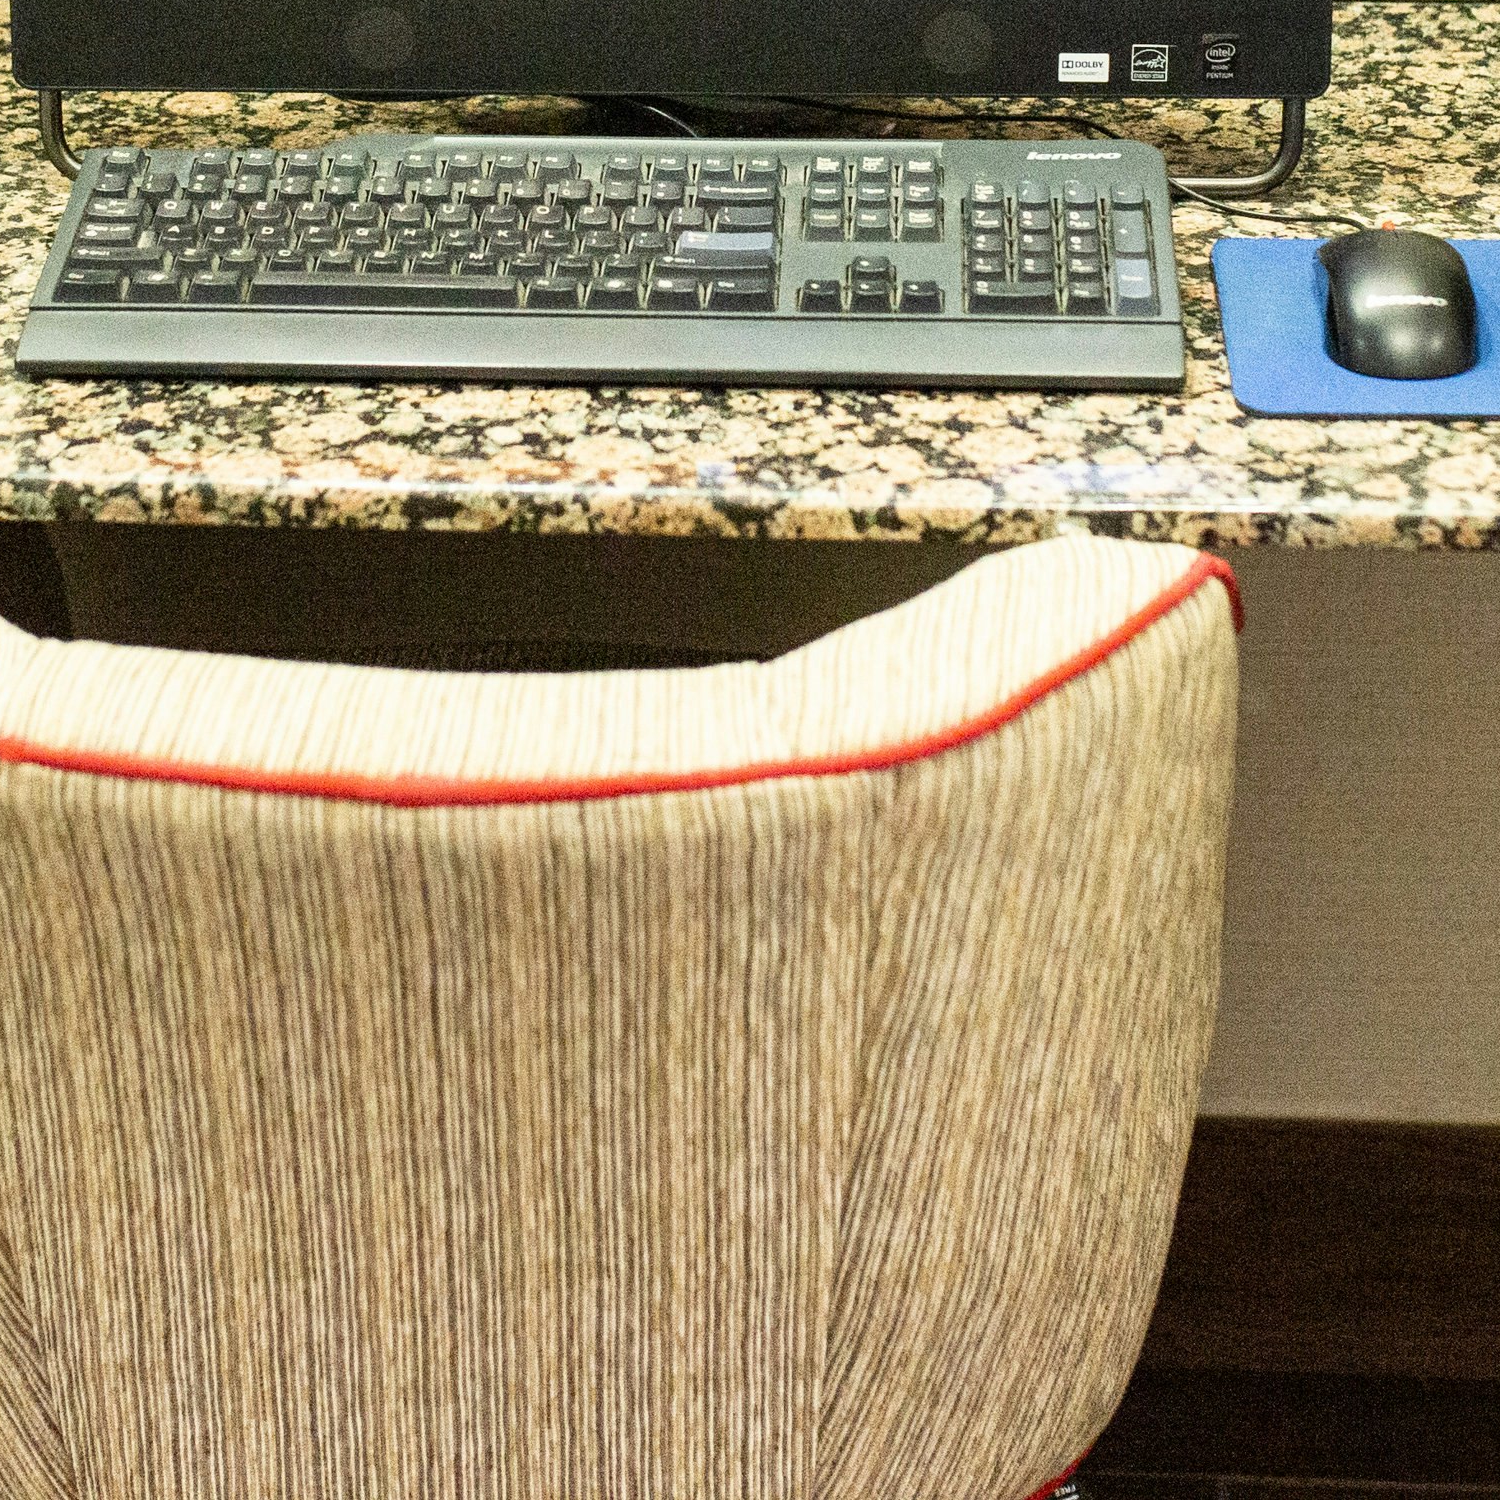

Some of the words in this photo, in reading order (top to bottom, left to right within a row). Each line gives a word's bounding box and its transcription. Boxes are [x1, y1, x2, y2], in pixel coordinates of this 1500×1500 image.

[1209, 46, 1232, 58] intel
[1074, 60, 1104, 69] DOLBY
[1206, 71, 1234, 80] PENTIUM
[1026, 151, 1122, 160] lenovo
[163, 200, 178, 211] Q
[210, 201, 224, 211] W
[255, 201, 269, 211] E
[349, 202, 361, 212] T
[396, 203, 408, 213] Y
[442, 204, 455, 214] U
[535, 205, 551, 215] O
[583, 206, 595, 215] P
[167, 224, 181, 234] A
[261, 226, 275, 235] D
[403, 228, 417, 237] H
[448, 229, 460, 239] J
[496, 229, 509, 238] K
[544, 230, 555, 240] L
[420, 251, 435, 259] N
[468, 252, 484, 260] M
